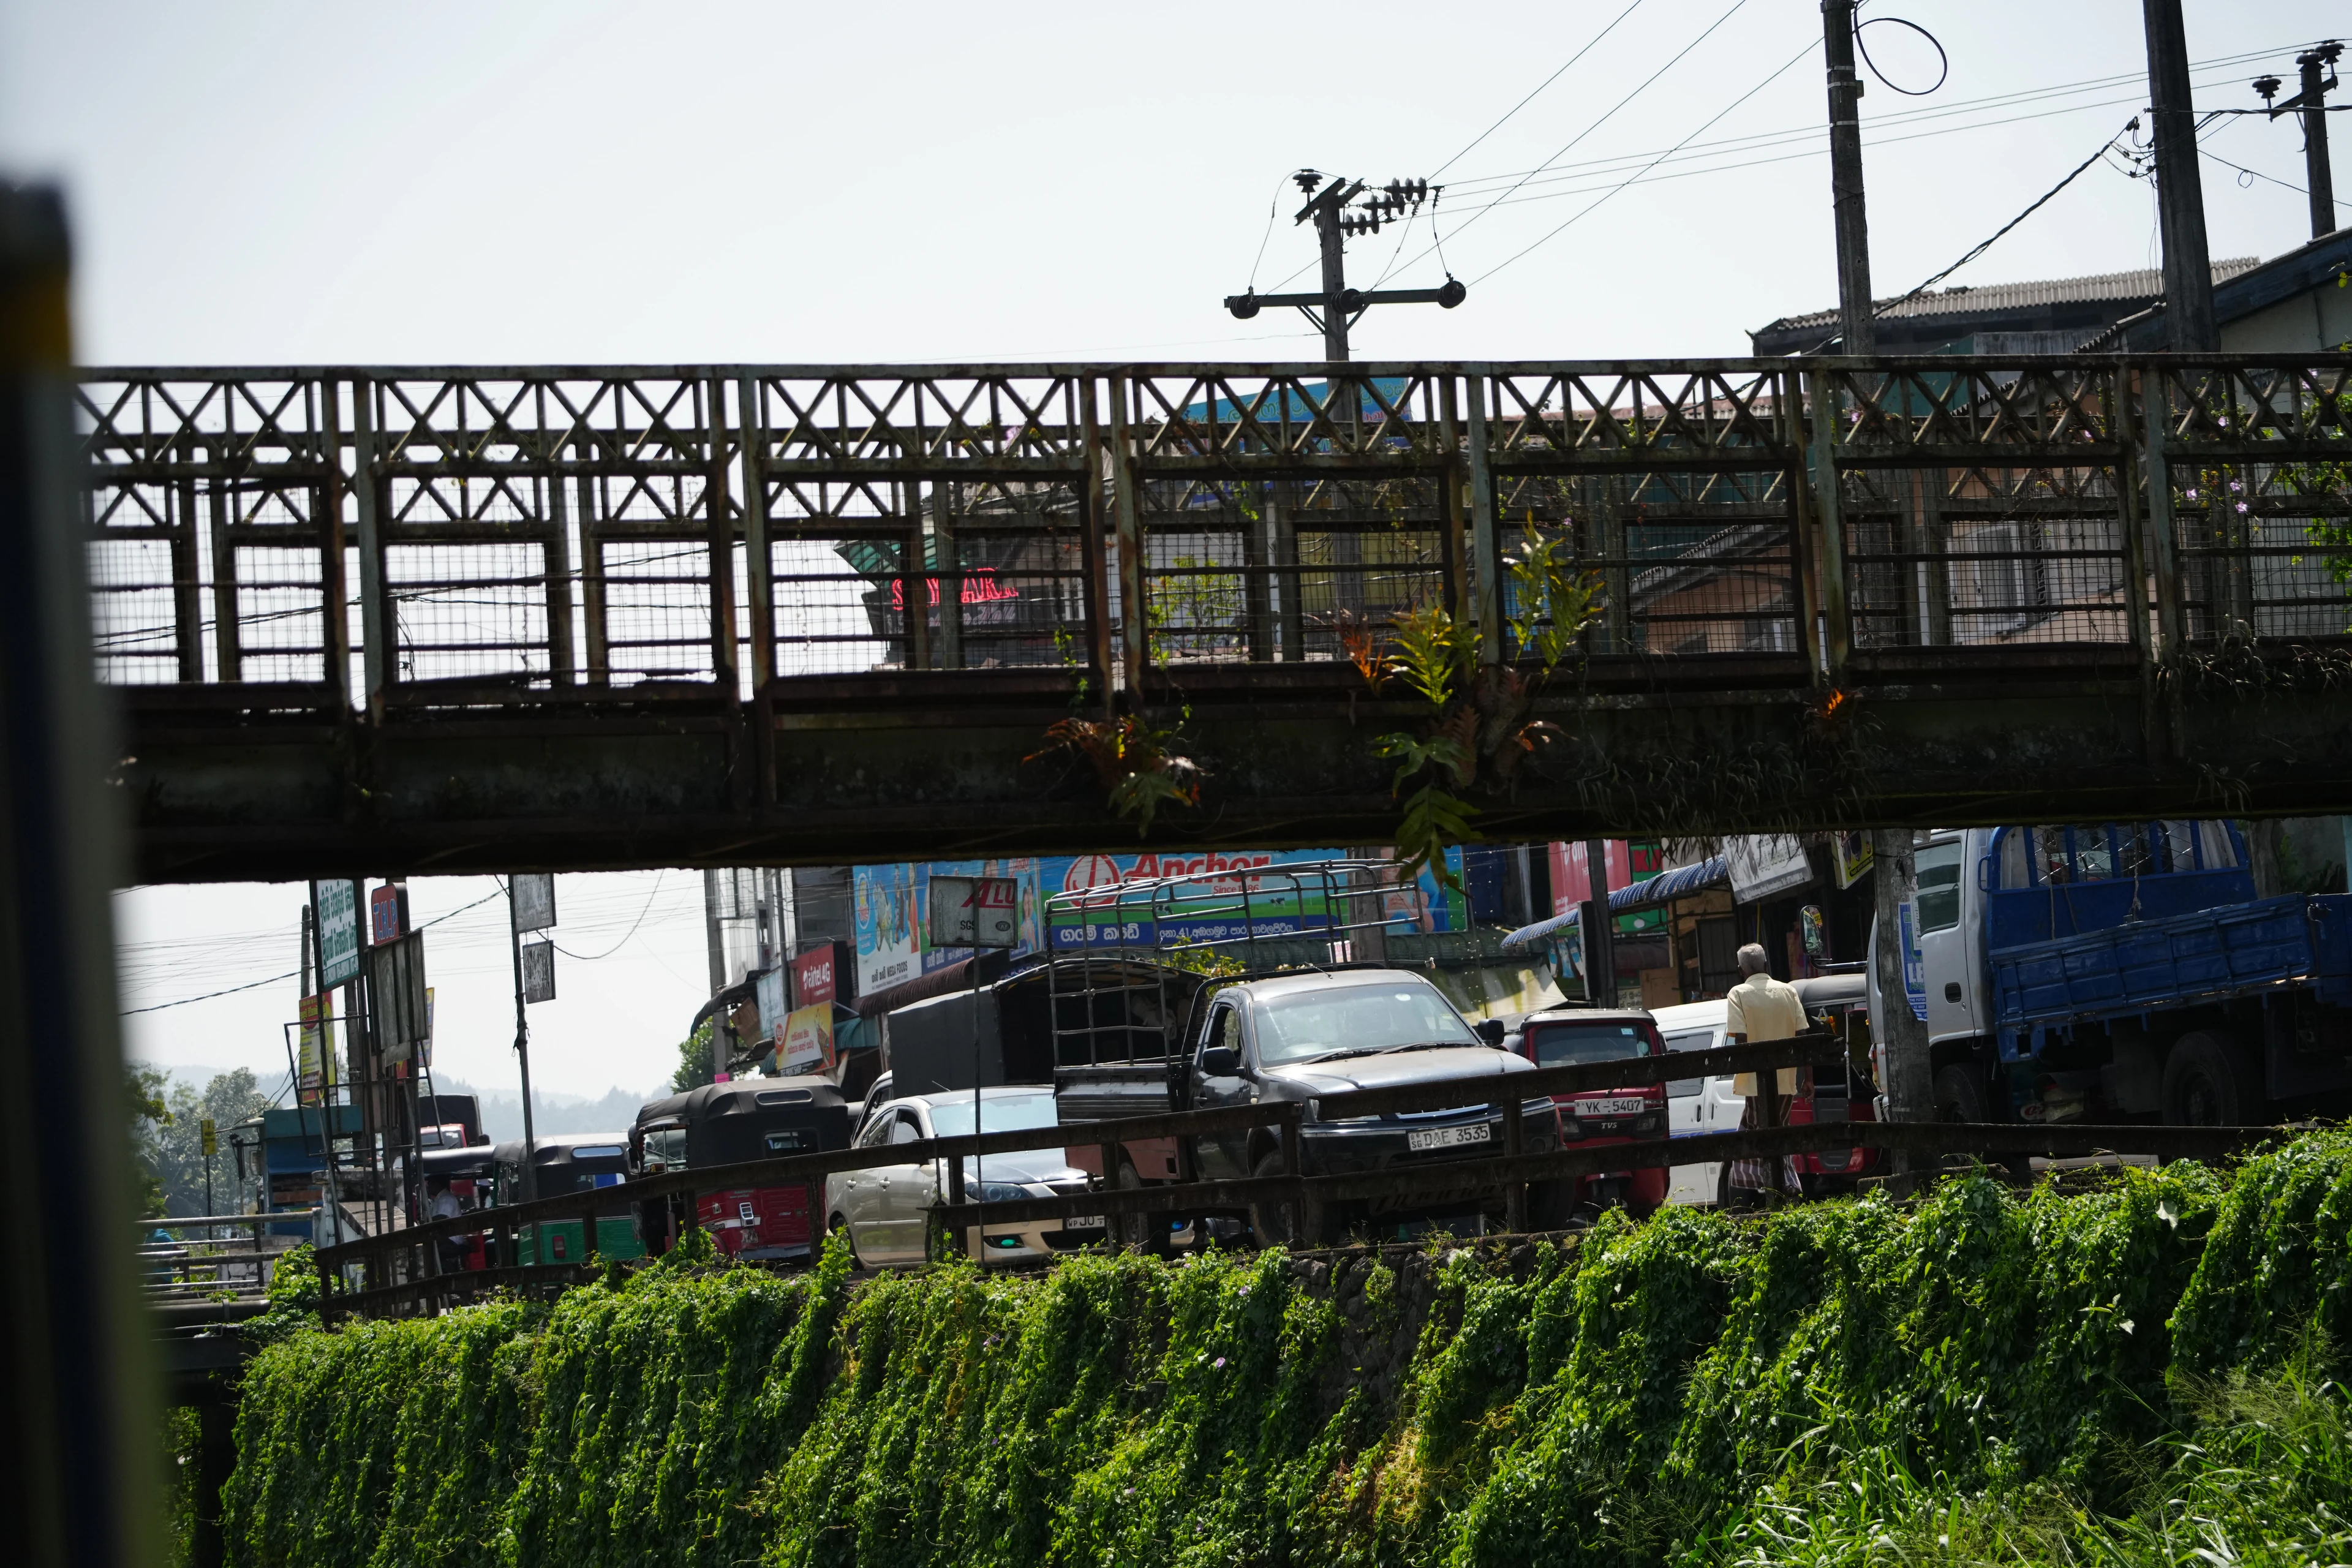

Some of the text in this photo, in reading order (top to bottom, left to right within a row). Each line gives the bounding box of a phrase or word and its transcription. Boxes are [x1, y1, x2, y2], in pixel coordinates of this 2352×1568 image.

[1123, 853, 1270, 885] Anchor
[1213, 885, 1237, 894] Since
[897, 960, 908, 974] FOODS
[808, 962, 831, 988] airtel 4G
[1586, 1102, 1600, 1113] YK
[1613, 1100, 1640, 1112] 5407
[1456, 1126, 1488, 1142] 3535
